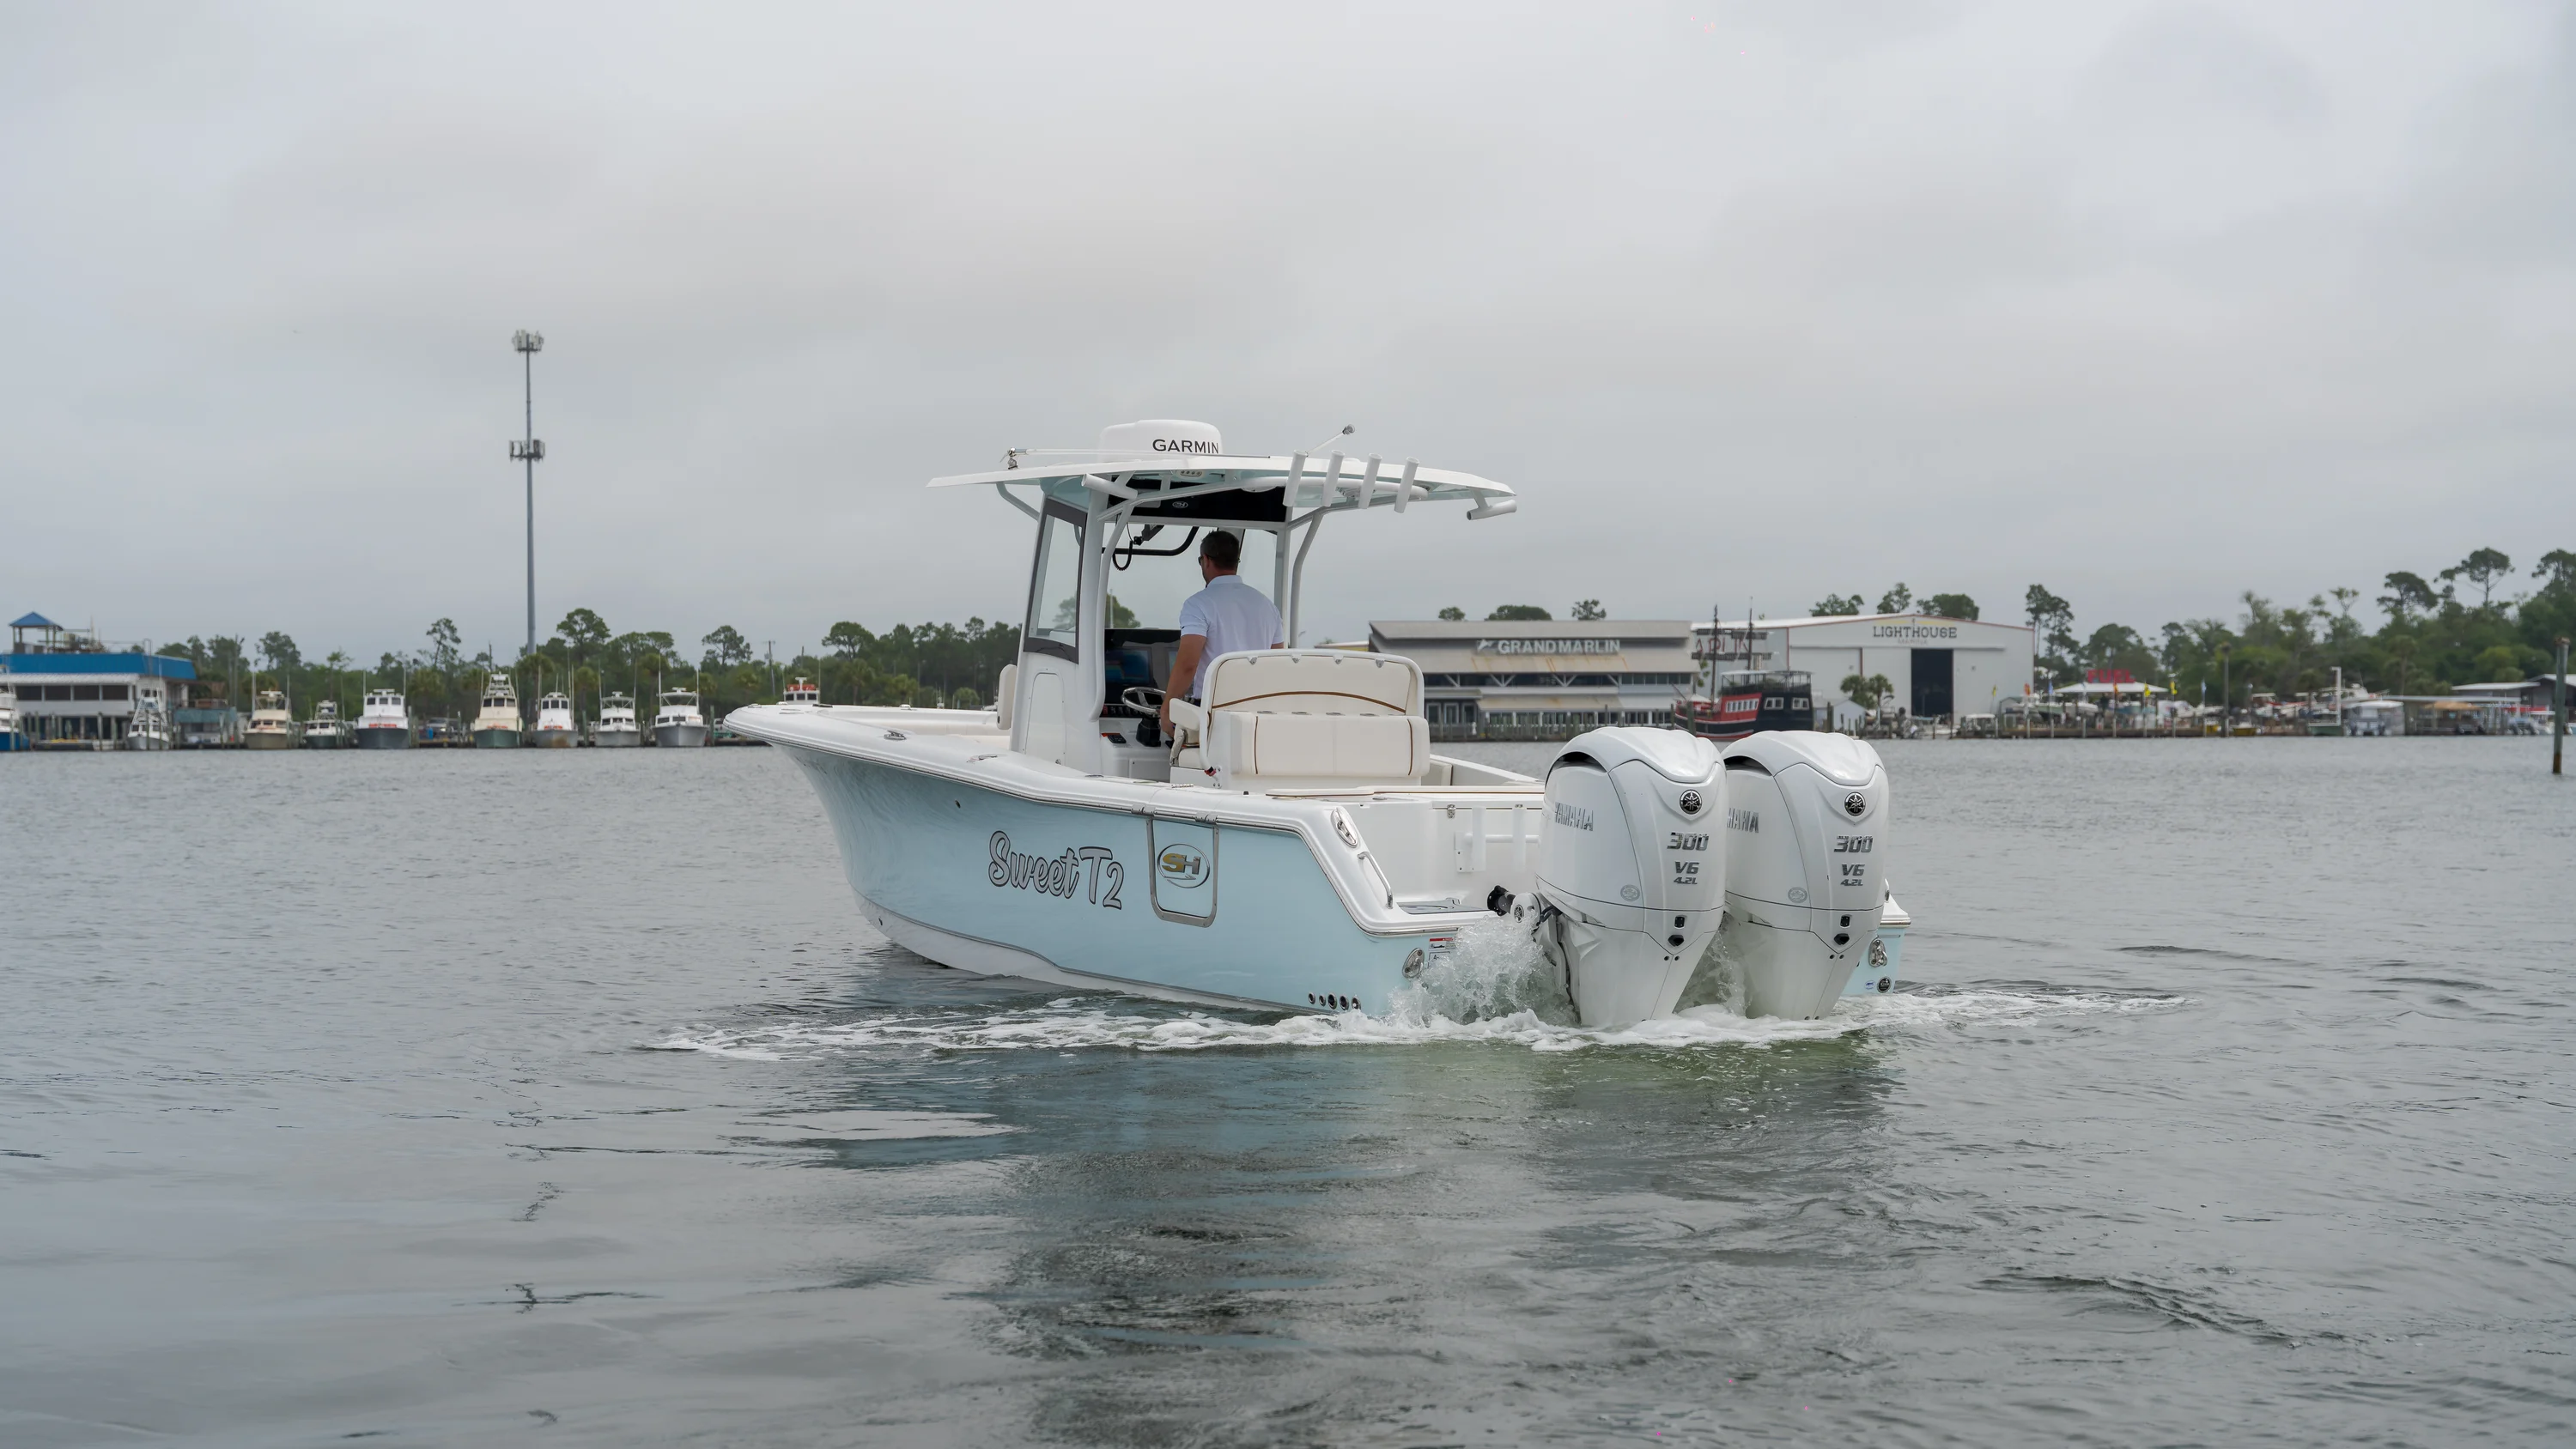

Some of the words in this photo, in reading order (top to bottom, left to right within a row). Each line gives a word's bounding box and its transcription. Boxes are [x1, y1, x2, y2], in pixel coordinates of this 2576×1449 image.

[1152, 439, 1219, 454] GARMIN
[1873, 626, 1958, 638] LIGHTHOUSE
[2087, 670, 2136, 683] FUEL
[1555, 802, 1594, 831] YAMAHA
[1667, 832, 1710, 851] 300
[1833, 835, 1873, 852] 300
[988, 830, 1079, 899] Sweet
[1078, 846, 1124, 910] T2
[1674, 861, 1699, 874] V6
[1841, 864, 1865, 876] V6
[1674, 876, 1698, 885] 4.2L
